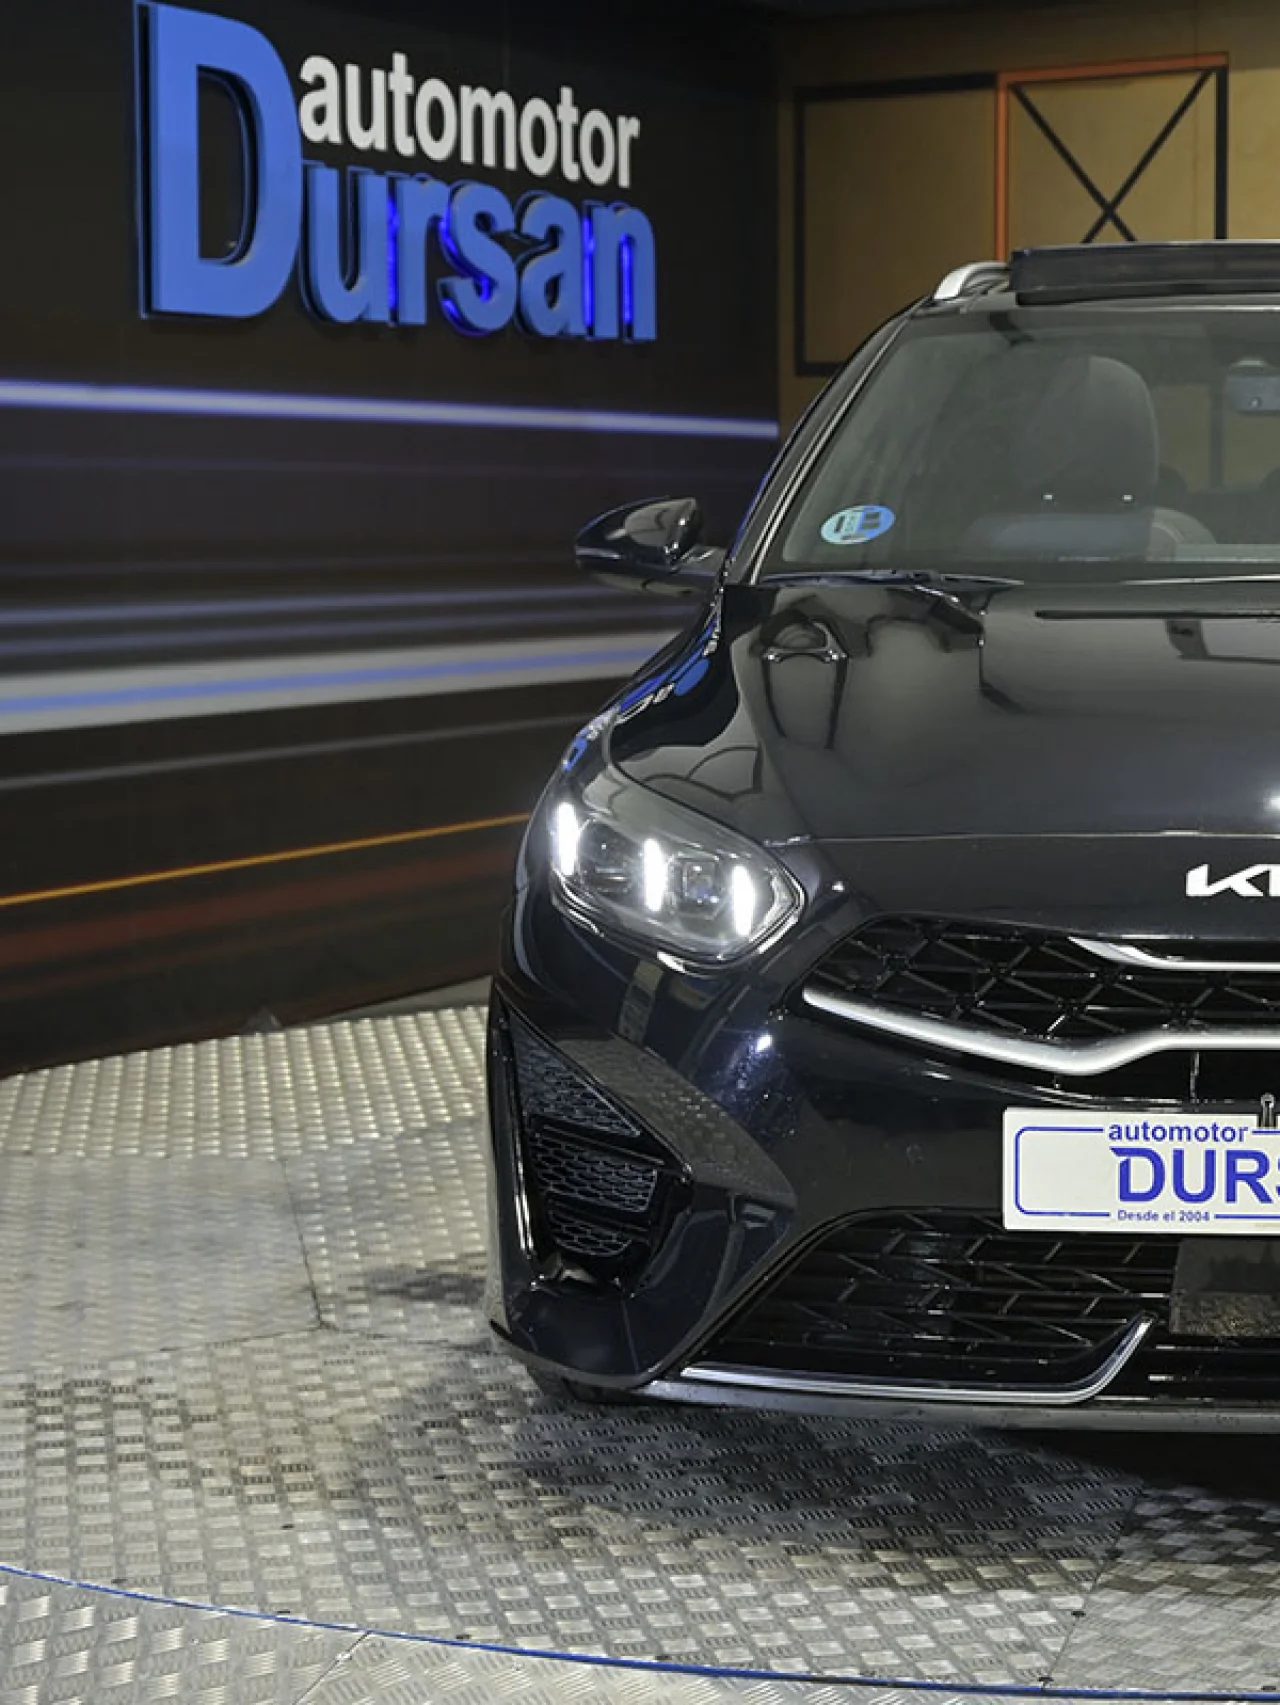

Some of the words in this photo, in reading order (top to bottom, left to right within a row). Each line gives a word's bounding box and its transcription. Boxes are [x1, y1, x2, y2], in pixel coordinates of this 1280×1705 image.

[300, 52, 641, 188] automotor
[135, 1, 658, 342] Dursan
[1108, 1121, 1249, 1143] automotor
[1117, 1209, 1159, 1222] Desde
[1162, 1209, 1176, 1222] el
[1179, 1209, 1211, 1222] 2004
